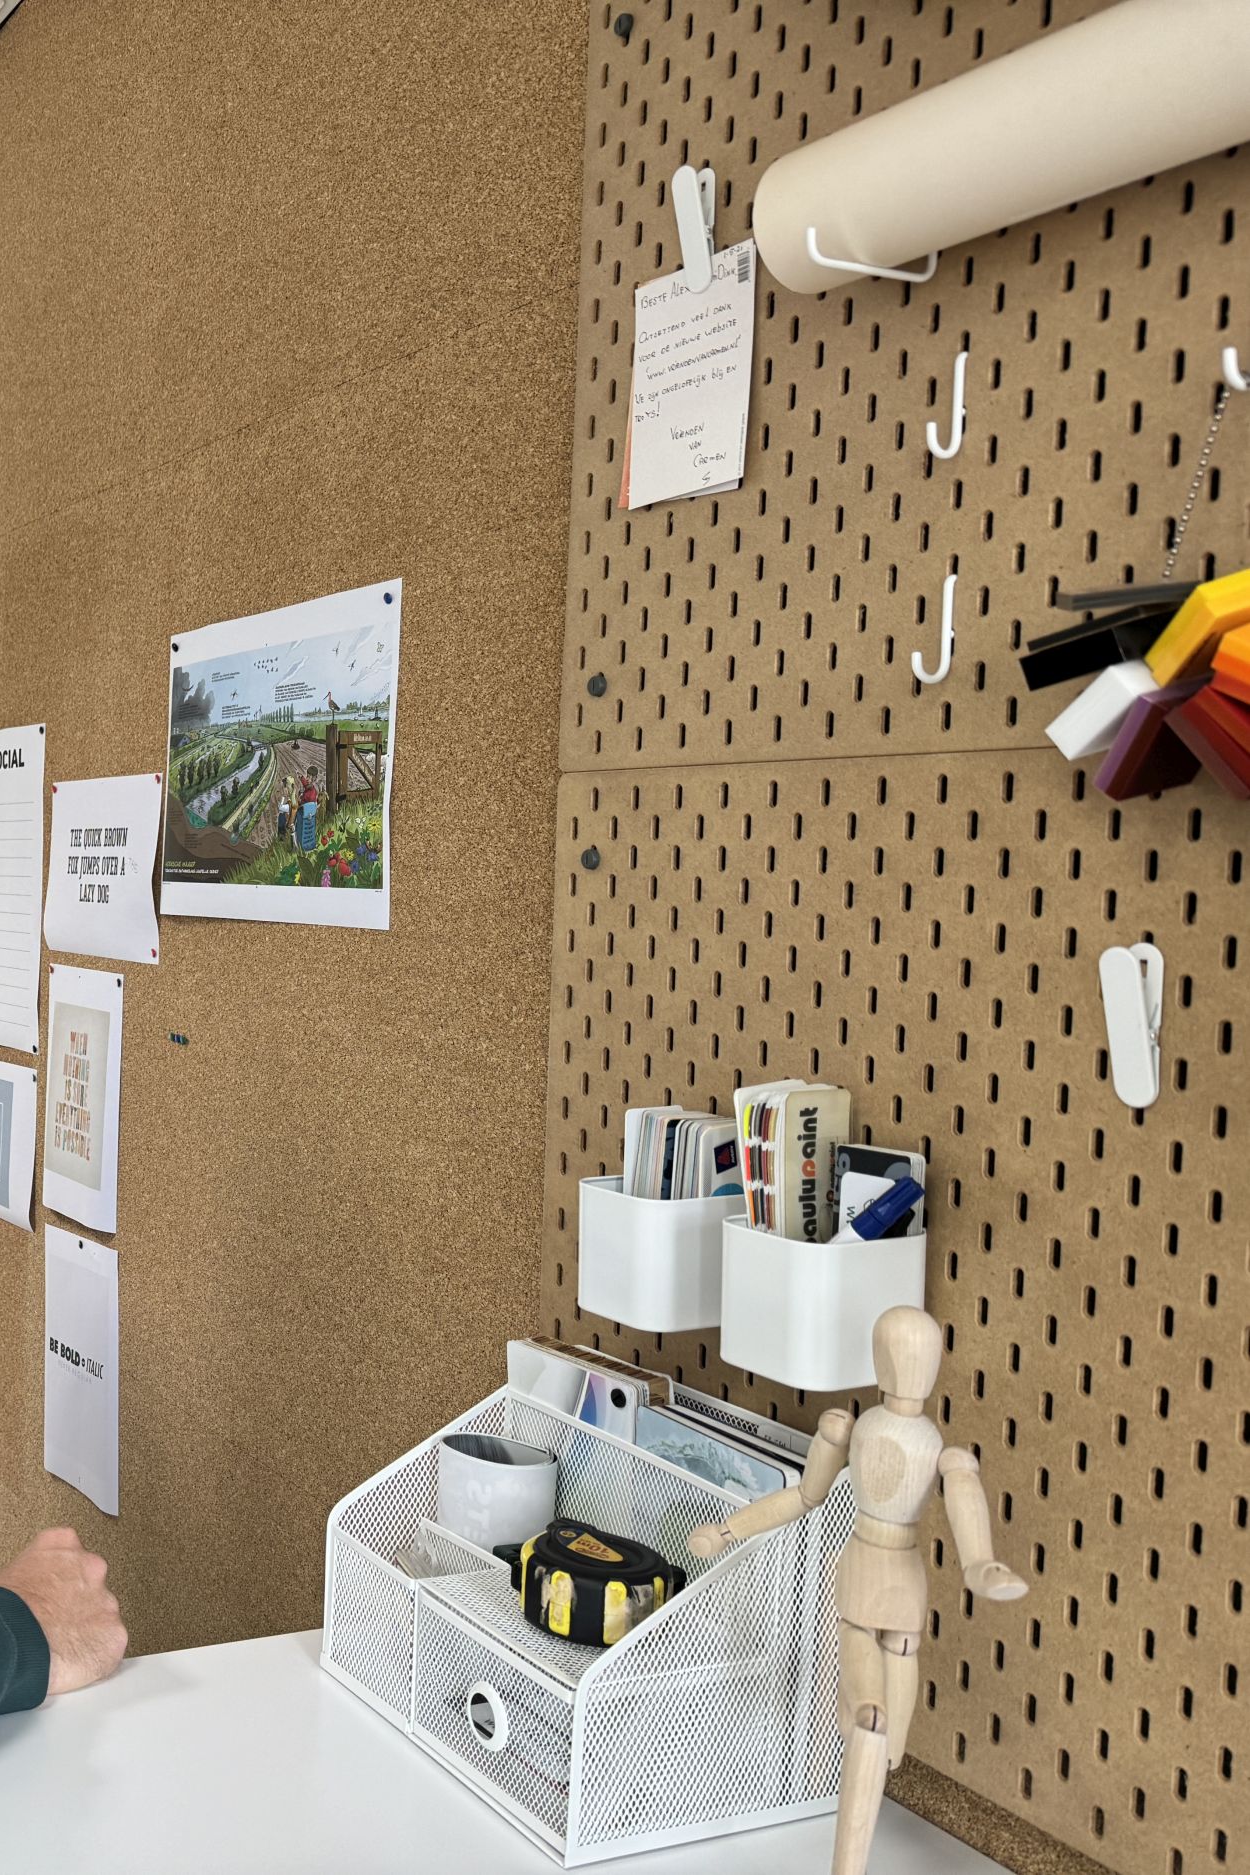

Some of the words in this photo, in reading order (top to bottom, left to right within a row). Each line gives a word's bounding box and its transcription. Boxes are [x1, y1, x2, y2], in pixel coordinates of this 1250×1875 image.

[640, 292, 667, 309] BESTE
[713, 303, 732, 315] DANK
[638, 351, 656, 363] VOOR
[69, 828, 83, 847] THE
[83, 828, 103, 850] QUICK
[103, 827, 128, 847] BROWN
[67, 856, 79, 874] FOX
[78, 856, 100, 880] JUMPS
[101, 856, 119, 876] OVER
[120, 856, 126, 876] A
[79, 884, 96, 902] LAZY
[97, 884, 110, 904] DOG
[70, 1031, 88, 1056] WHEN
[64, 1078, 72, 1101] IS
[55, 1101, 91, 1134] EVERYTHING
[54, 1125, 61, 1149] IS
[62, 1129, 91, 1161] POSSIBLE
[49, 1336, 59, 1354] BE
[60, 1342, 81, 1367] BOLD
[85, 1357, 105, 1380] ITALIC
